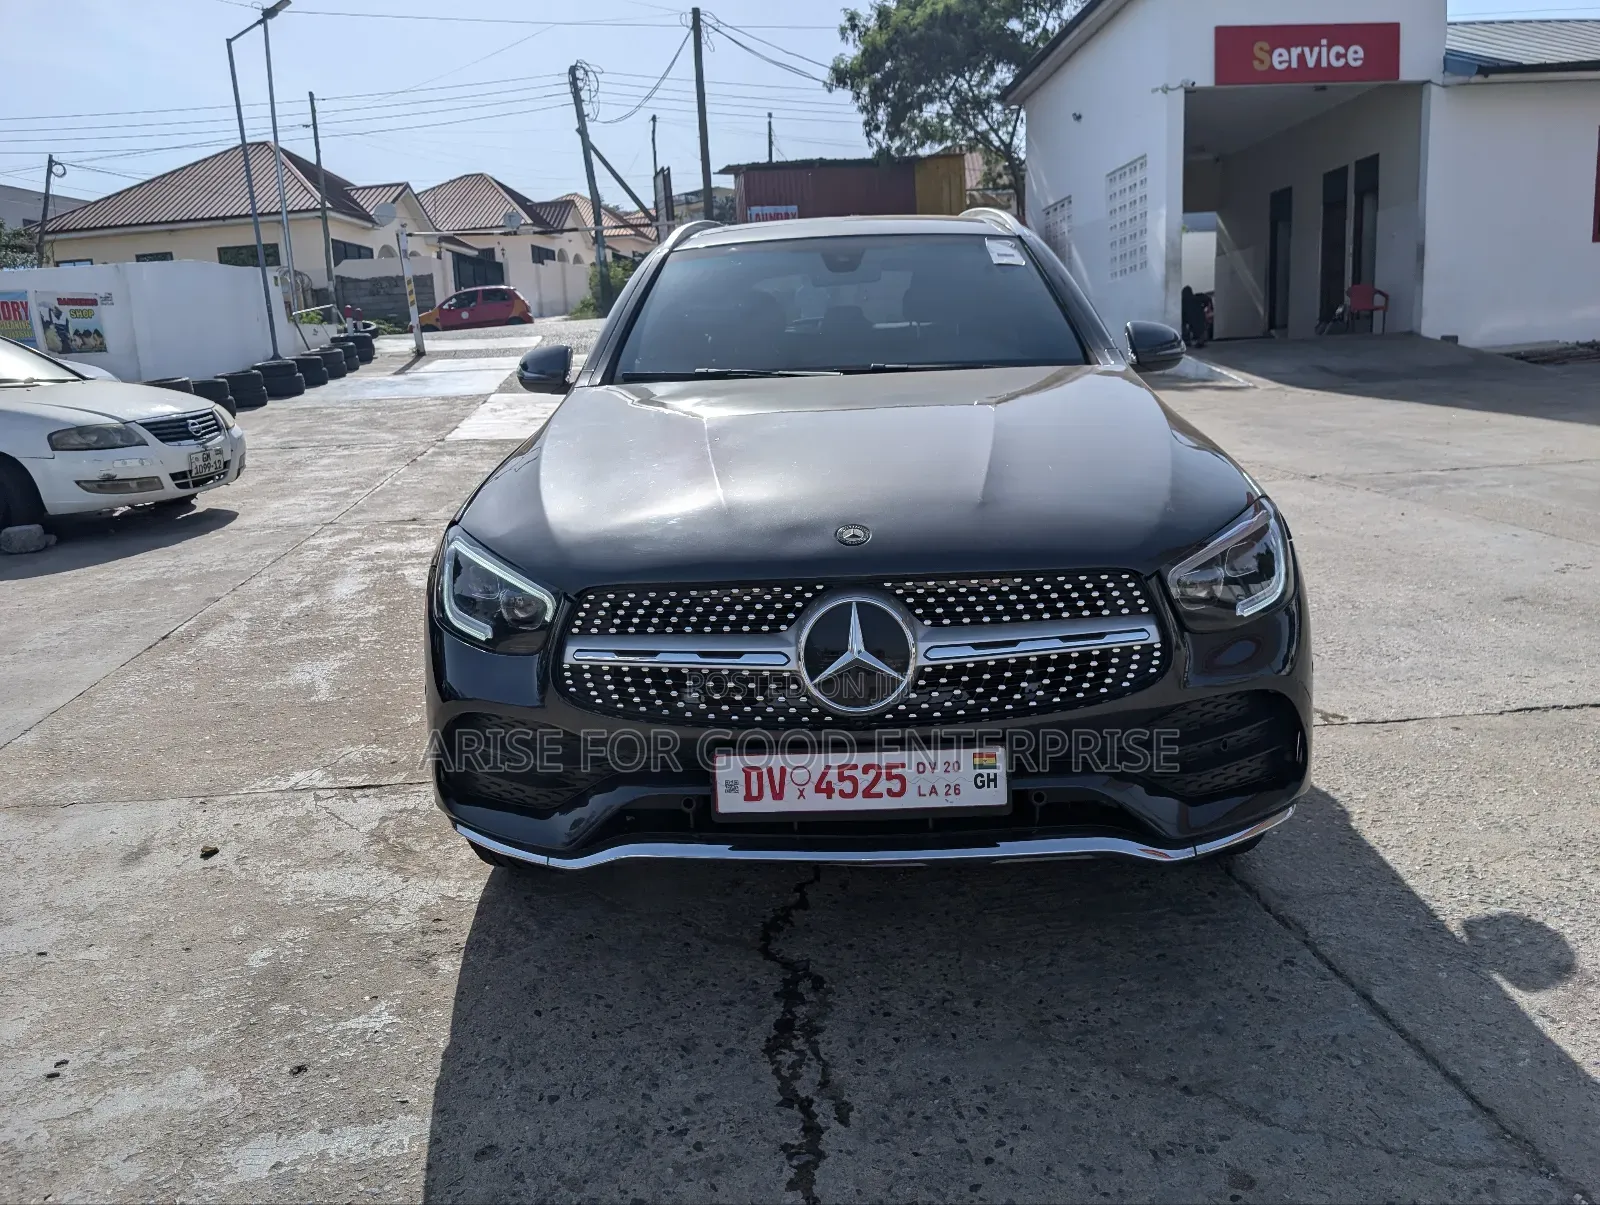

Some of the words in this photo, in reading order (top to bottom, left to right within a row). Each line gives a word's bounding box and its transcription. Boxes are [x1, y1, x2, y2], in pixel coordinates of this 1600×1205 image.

[1252, 38, 1365, 72] Service
[69, 308, 95, 319] SHOP
[194, 460, 222, 475] 1099-12
[916, 762, 937, 775] DV
[943, 761, 961, 773] 20
[742, 765, 786, 801] DV
[814, 762, 907, 800] 4525
[973, 772, 998, 790] GH
[917, 785, 938, 797] LA
[944, 783, 962, 796] 26
